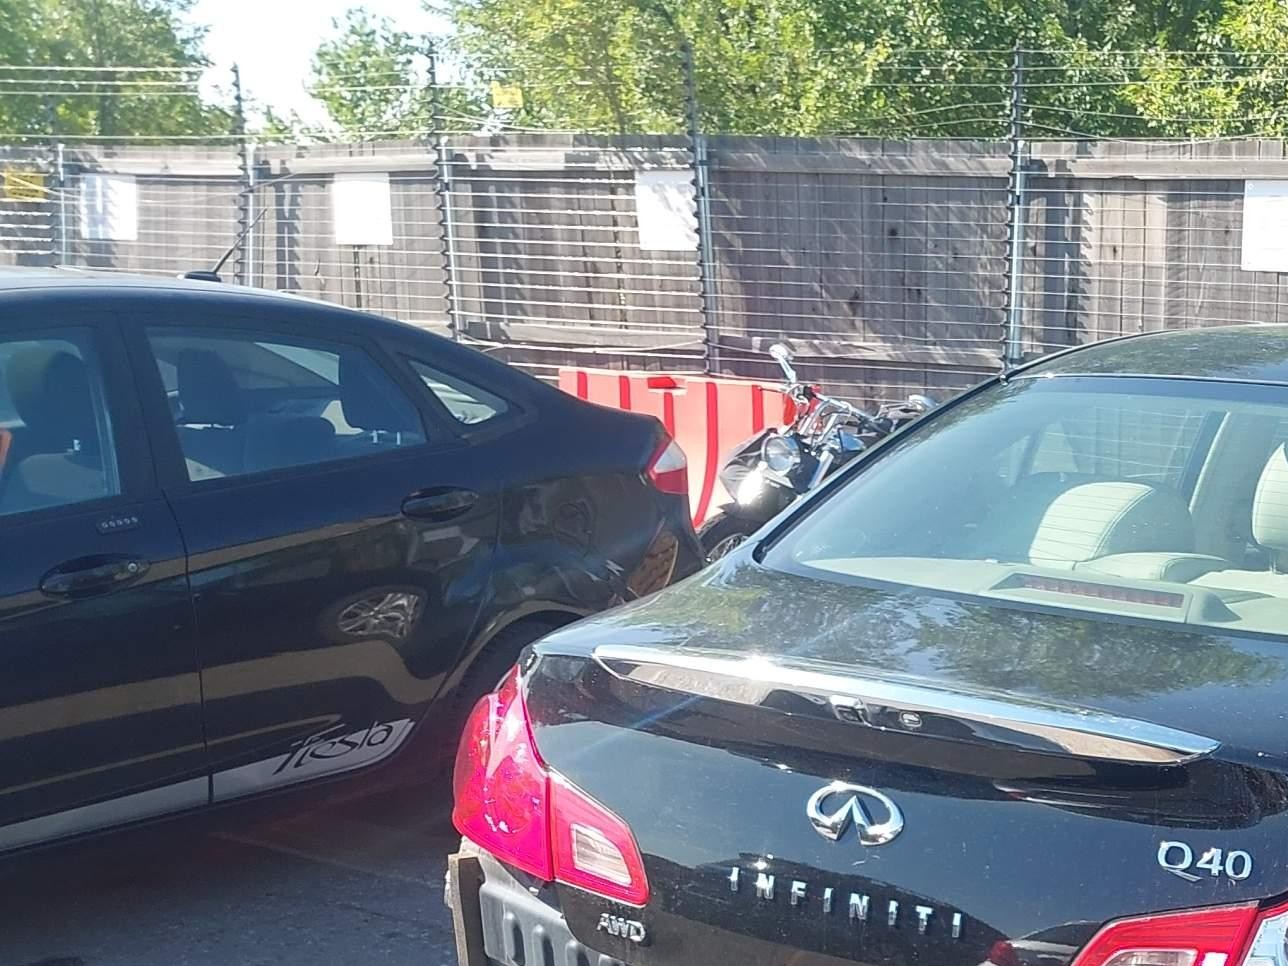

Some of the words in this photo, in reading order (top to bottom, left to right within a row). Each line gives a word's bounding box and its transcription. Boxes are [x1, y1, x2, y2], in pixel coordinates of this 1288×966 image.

[1157, 840, 1253, 882] Q40
[729, 866, 962, 939] INFINITI
[596, 912, 647, 943] AWD
